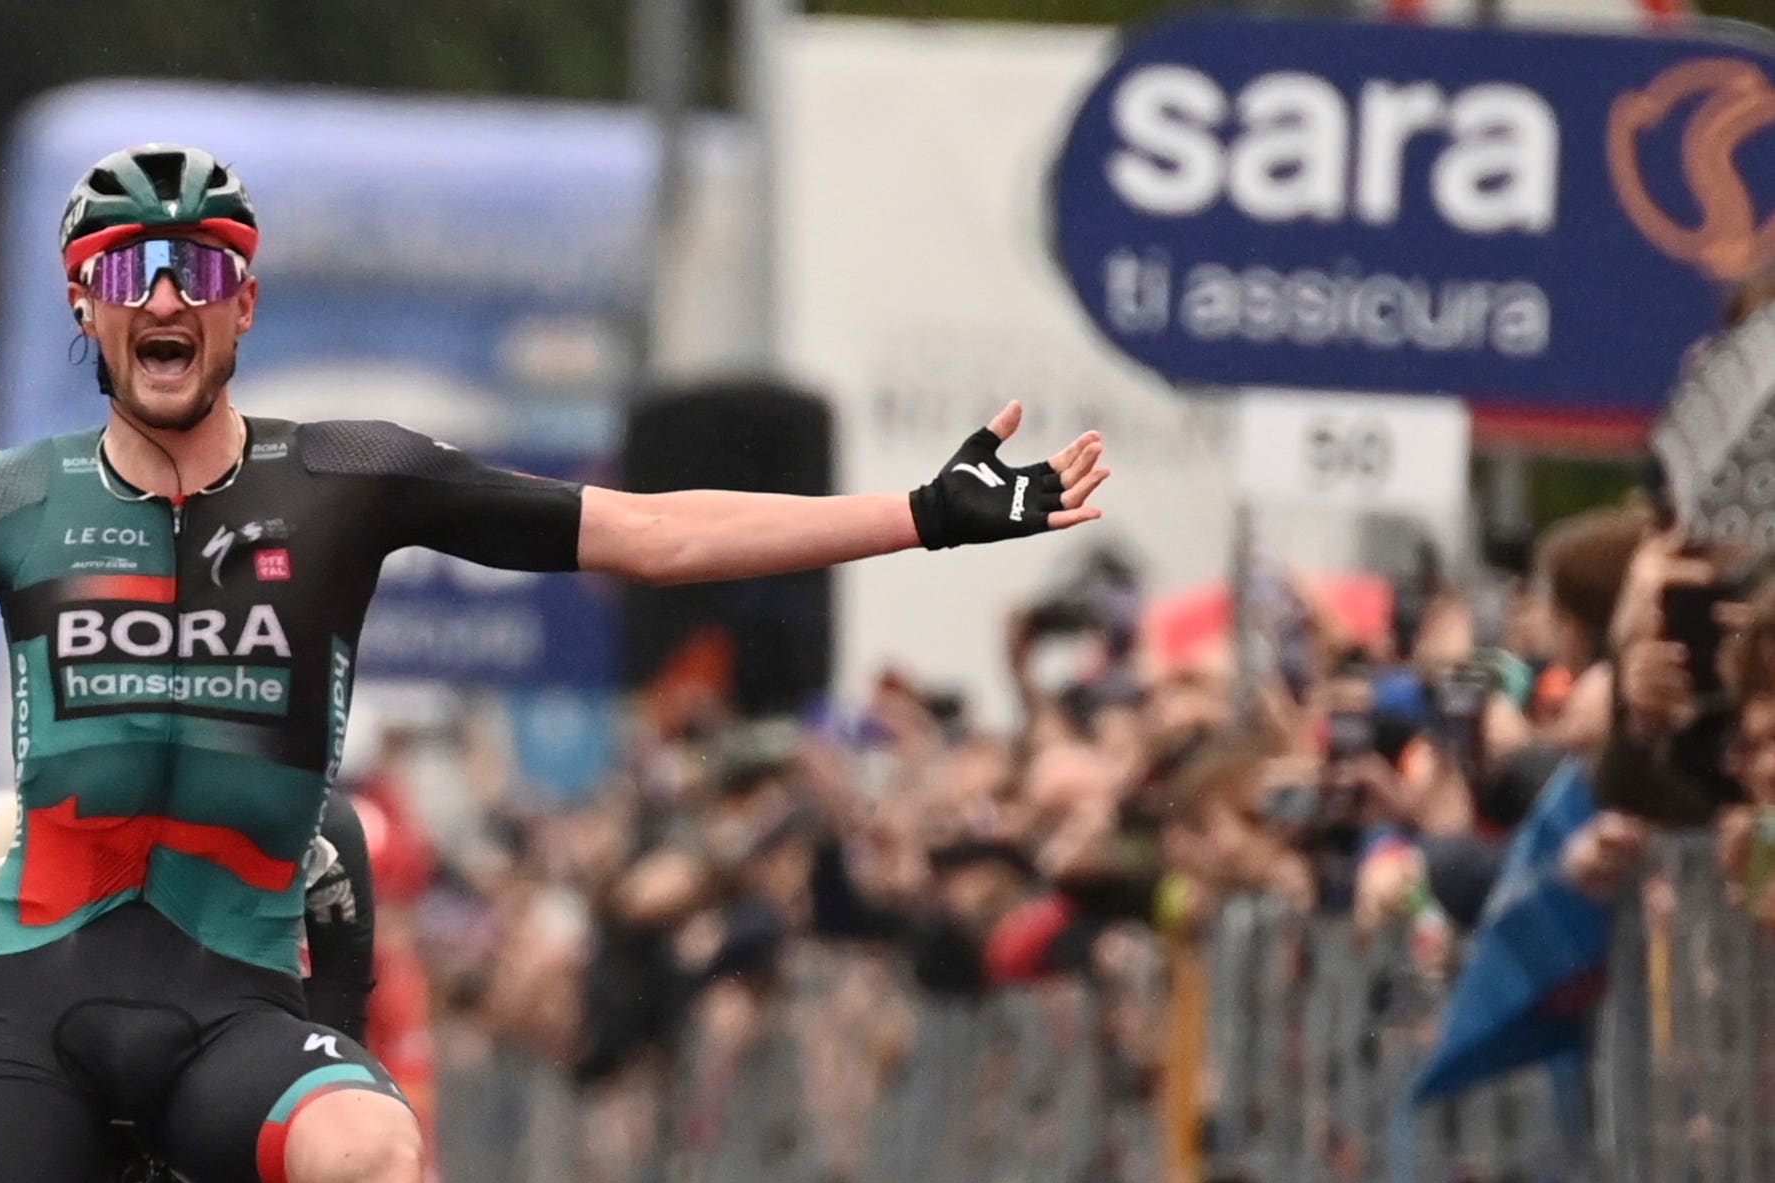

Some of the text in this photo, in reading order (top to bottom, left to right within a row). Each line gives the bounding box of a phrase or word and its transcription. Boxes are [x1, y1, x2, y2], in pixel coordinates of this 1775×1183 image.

[1108, 63, 1558, 234] sara
[1105, 245, 1551, 357] ti assicura
[64, 527, 151, 547] LE COL
[58, 604, 292, 658] BORA
[66, 665, 283, 702] hansgrohe
